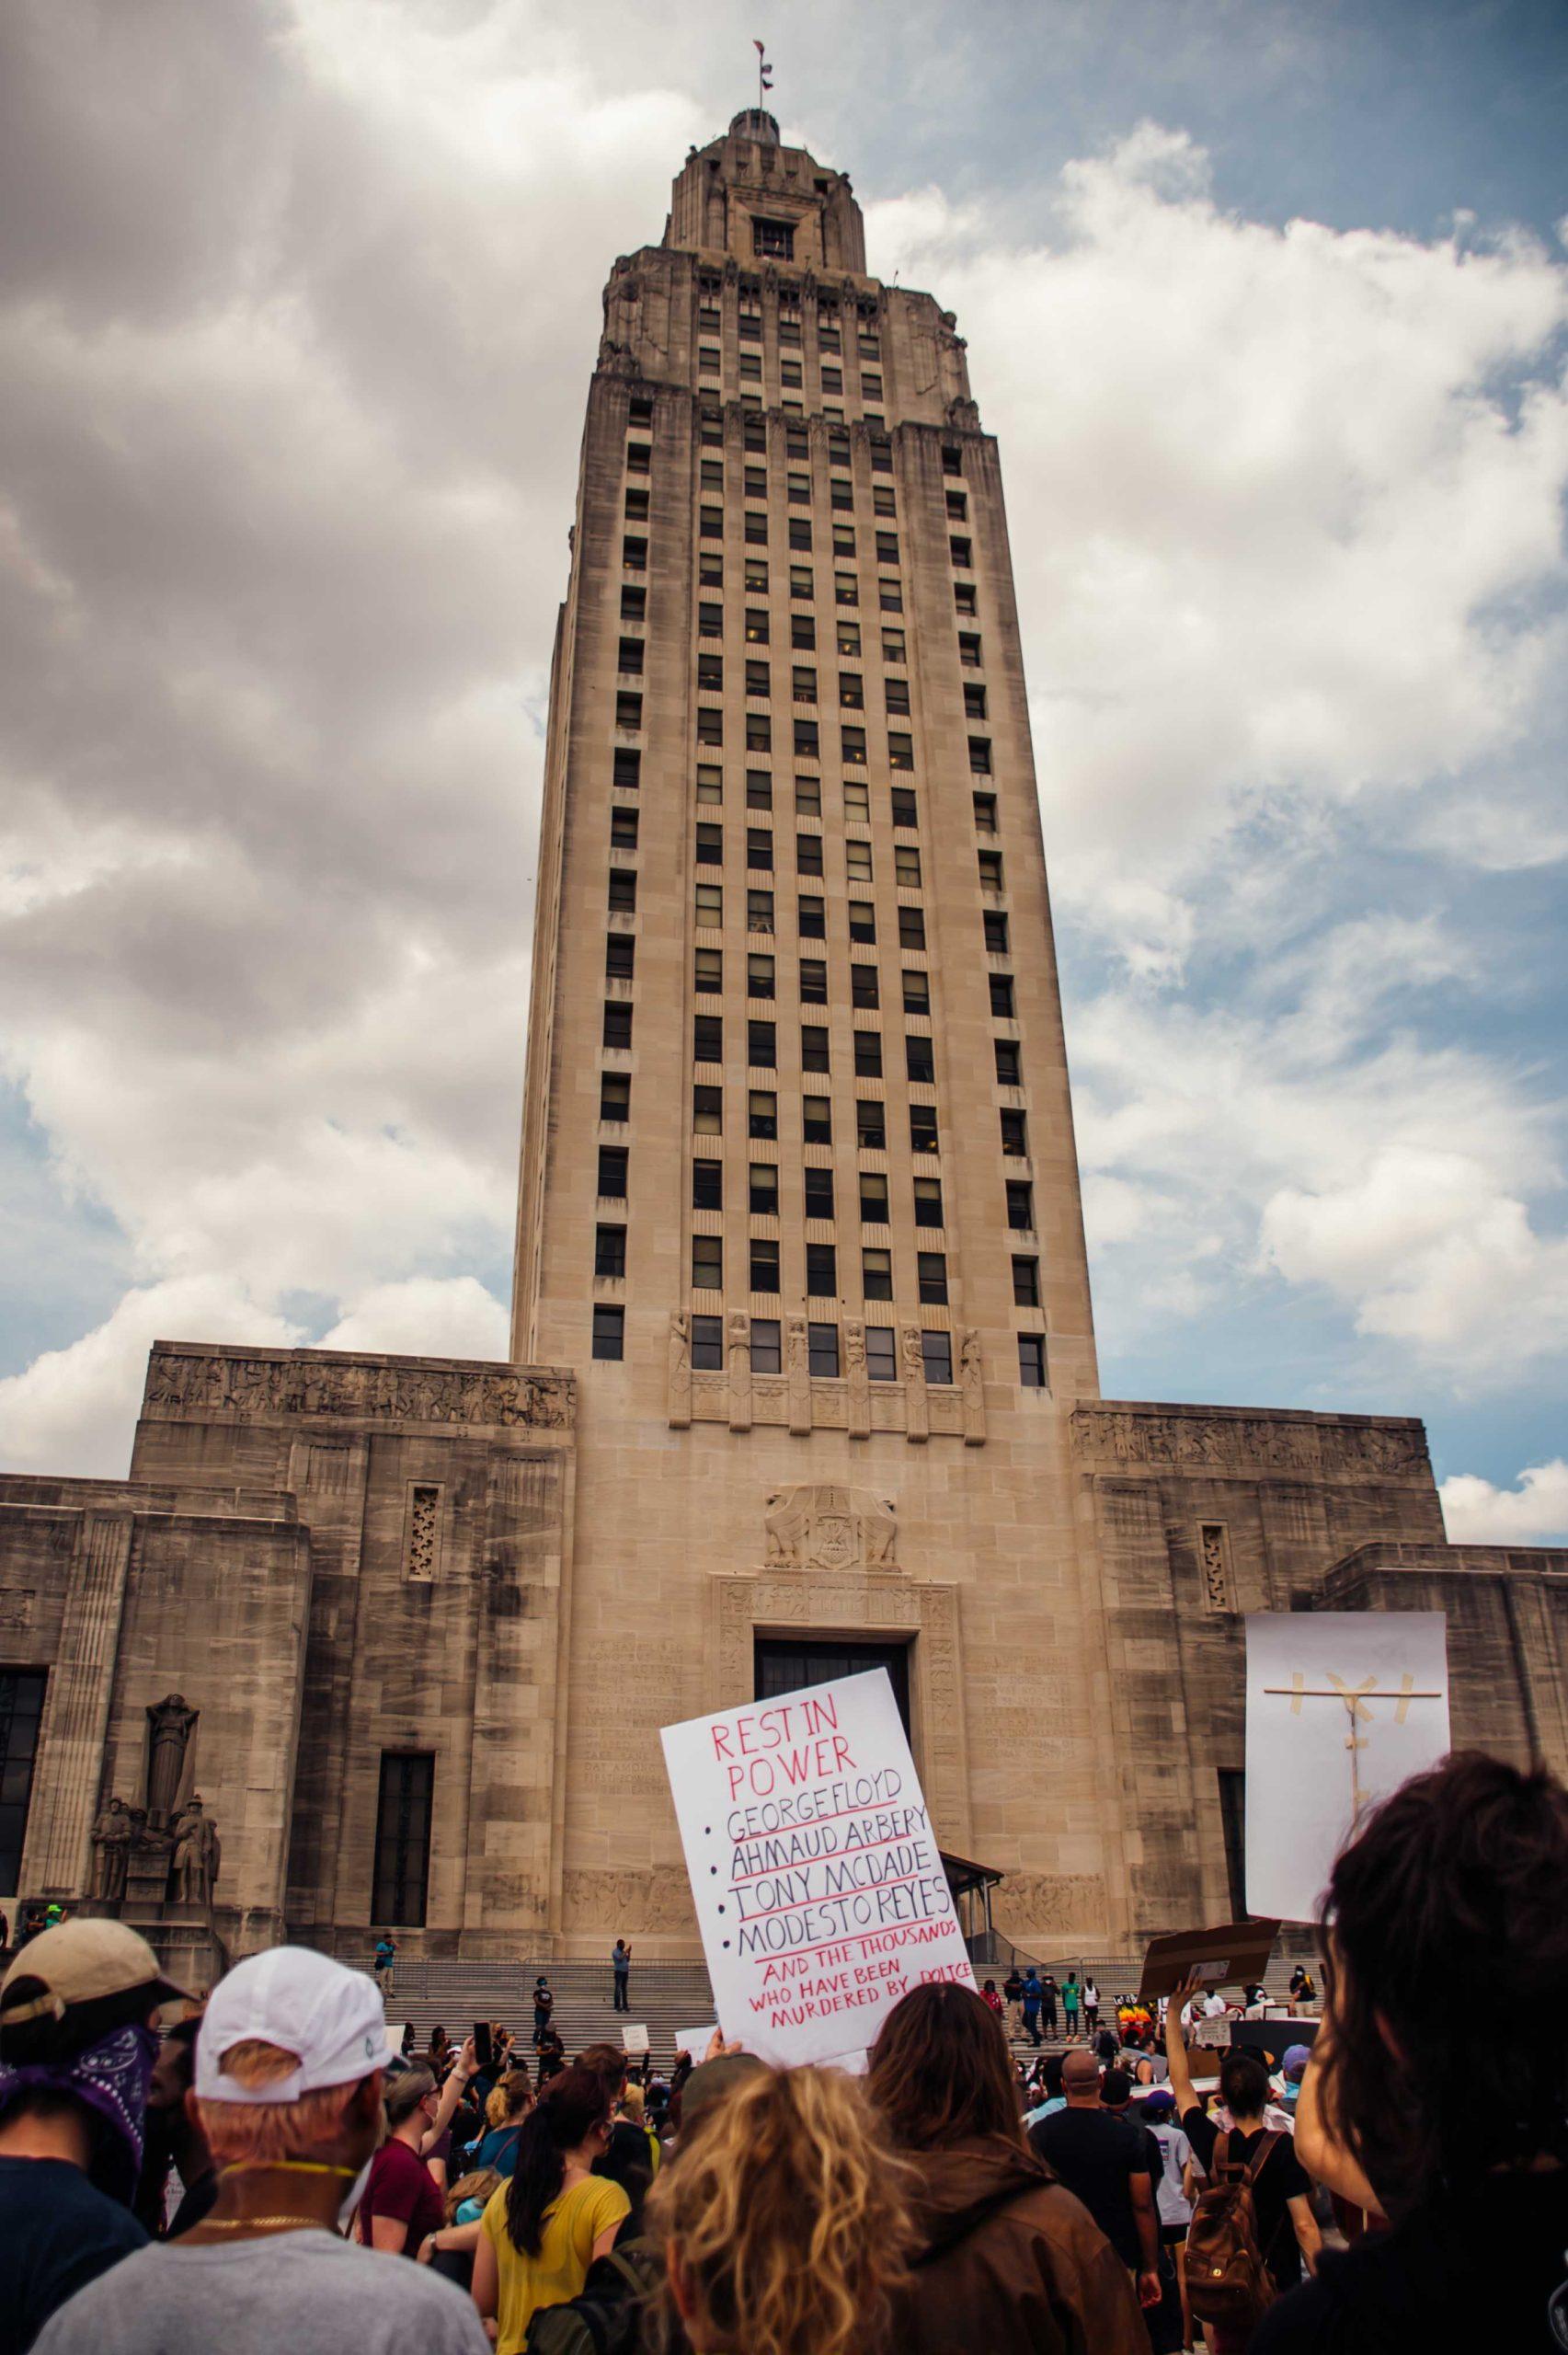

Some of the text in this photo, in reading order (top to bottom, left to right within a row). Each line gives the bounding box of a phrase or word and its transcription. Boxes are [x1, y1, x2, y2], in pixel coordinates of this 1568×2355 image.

[712, 1694, 838, 1761] REST IN
[727, 1736, 857, 1801] POWER
[727, 1769, 902, 1841] GEORGE FLOYD
[731, 1805, 926, 1880] AHMAUD ARBERY
[727, 1841, 932, 1920] TONY MCDADE
[738, 1877, 951, 1957] MODESTO REYES
[749, 1959, 900, 2012] WHO HAVE BEEN
[762, 1920, 957, 1985] AND THE THOUSANDS
[772, 1987, 879, 2028] MURDERED
[887, 1975, 909, 1996] BY
